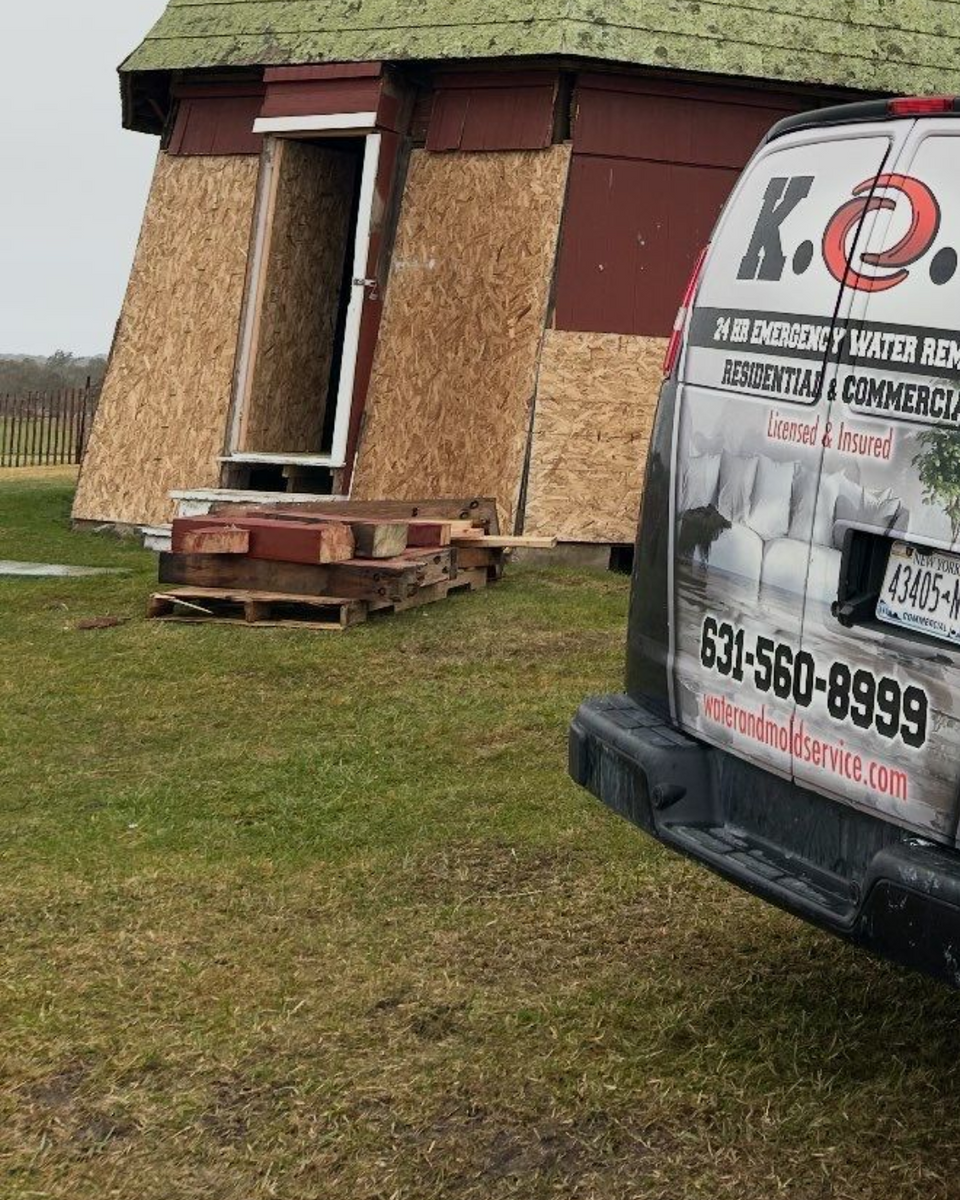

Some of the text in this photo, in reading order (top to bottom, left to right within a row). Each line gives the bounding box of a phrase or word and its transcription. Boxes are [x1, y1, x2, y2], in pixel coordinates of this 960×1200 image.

[714, 316, 731, 341] 24
[730, 318, 750, 343] HR
[750, 319, 846, 354] EMERGENCY
[850, 328, 918, 365] WATER
[721, 359, 822, 398] RESIDENTIAL
[827, 378, 837, 401] &
[768, 410, 893, 460] Licensed & Insured
[913, 551, 960, 576] NEW YORK
[902, 612, 947, 632] COMMERCIAL
[700, 617, 928, 748] 631-560-8999
[703, 693, 908, 801] waterandmoldservice.com
